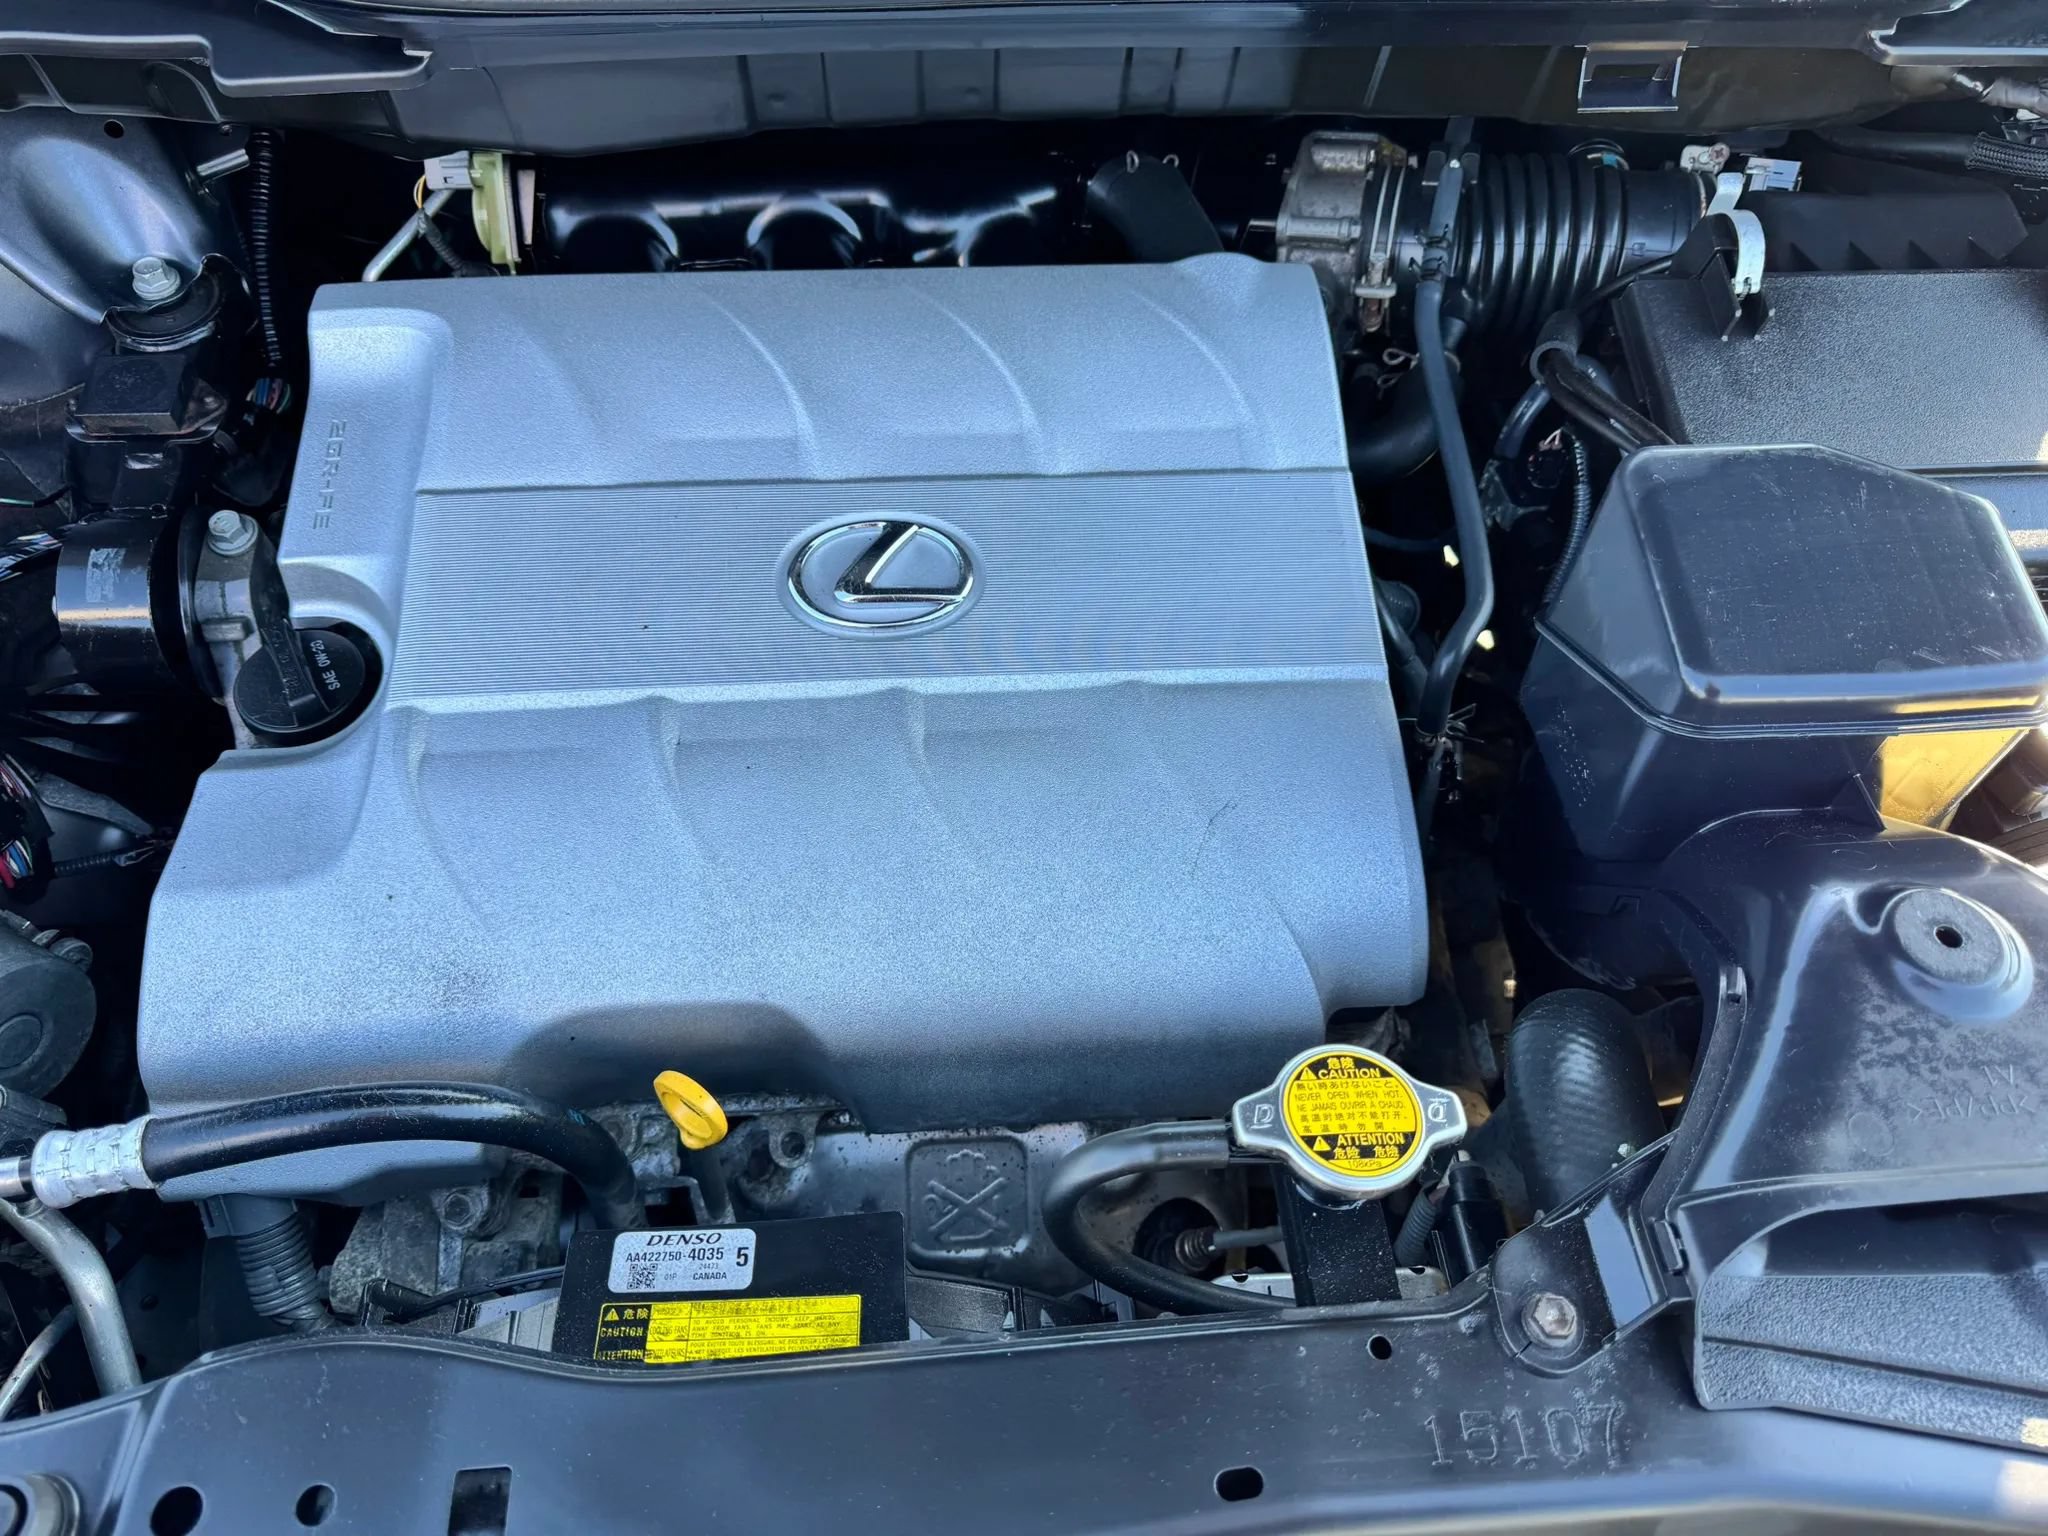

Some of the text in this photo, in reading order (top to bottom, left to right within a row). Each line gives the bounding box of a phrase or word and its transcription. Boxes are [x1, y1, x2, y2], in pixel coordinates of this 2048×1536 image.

[312, 419, 347, 530] 2GR-FE
[309, 639, 341, 692] SAE 0W-20
[1318, 1067, 1381, 1080] CAUTION
[1294, 1092, 1321, 1102] NEVER
[1327, 1091, 1350, 1100] OPEN
[1356, 1090, 1378, 1099] WHEN
[1297, 1103, 1307, 1112] NE
[1311, 1102, 1337, 1111] JAMAIS
[1340, 1101, 1367, 1110] OUVRIR
[1336, 1133, 1405, 1146] ATTENTION
[646, 1233, 722, 1246] DENSO
[626, 1247, 749, 1267] AA422750-4035 5
[692, 1271, 727, 1281] CANADA
[600, 1327, 644, 1337] CAUTION
[597, 1349, 644, 1360] ATTENTION
[1424, 1398, 1625, 1468] 15107
